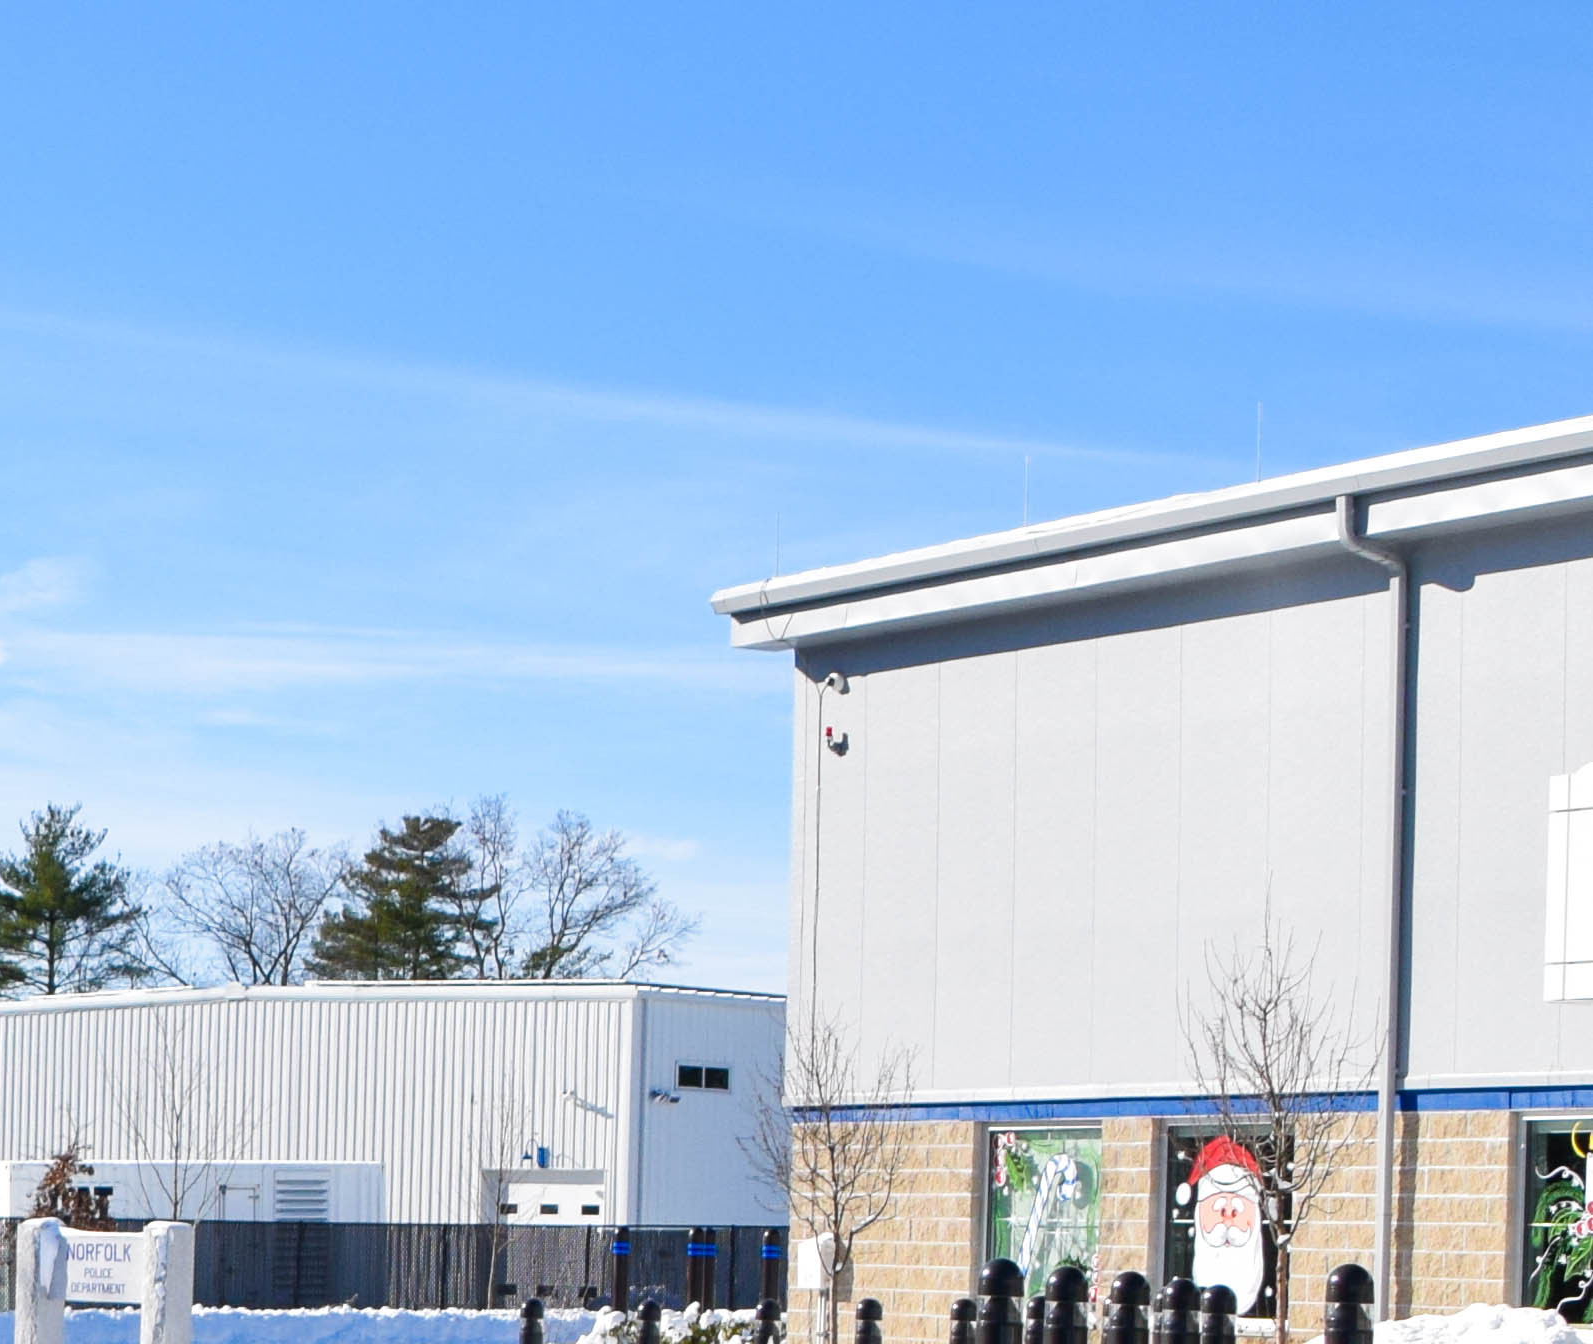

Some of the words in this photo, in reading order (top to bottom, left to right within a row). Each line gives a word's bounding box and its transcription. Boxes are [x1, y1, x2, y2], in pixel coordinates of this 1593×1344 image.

[66, 1243, 131, 1262] NORFOLK
[83, 1267, 113, 1279] POLICE
[71, 1282, 126, 1295] DEPARTMENT
